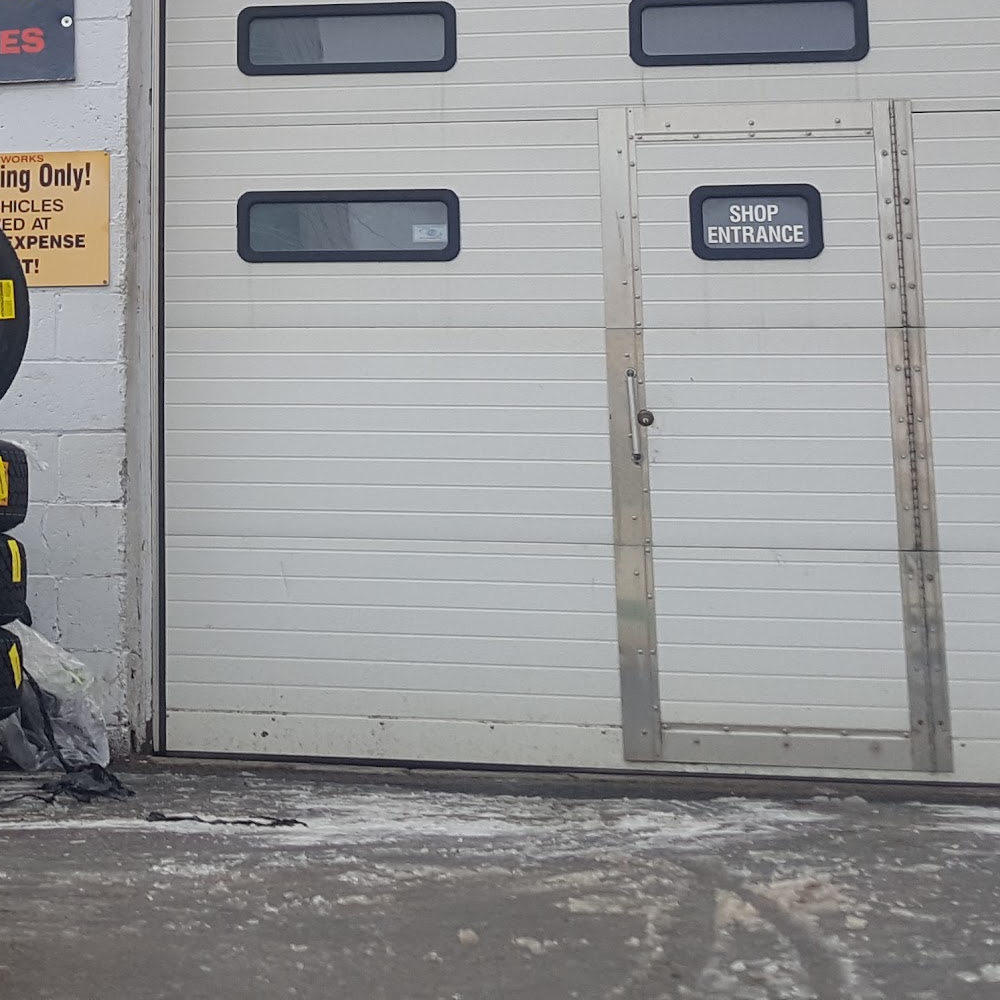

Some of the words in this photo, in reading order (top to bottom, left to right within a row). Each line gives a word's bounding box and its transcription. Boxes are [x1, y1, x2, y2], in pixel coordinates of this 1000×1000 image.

[1, 154, 44, 164] WORKS
[39, 162, 92, 191] Only!
[729, 204, 779, 223] SHOP
[31, 217, 52, 230] AT
[707, 225, 805, 244] ENTRANCE
